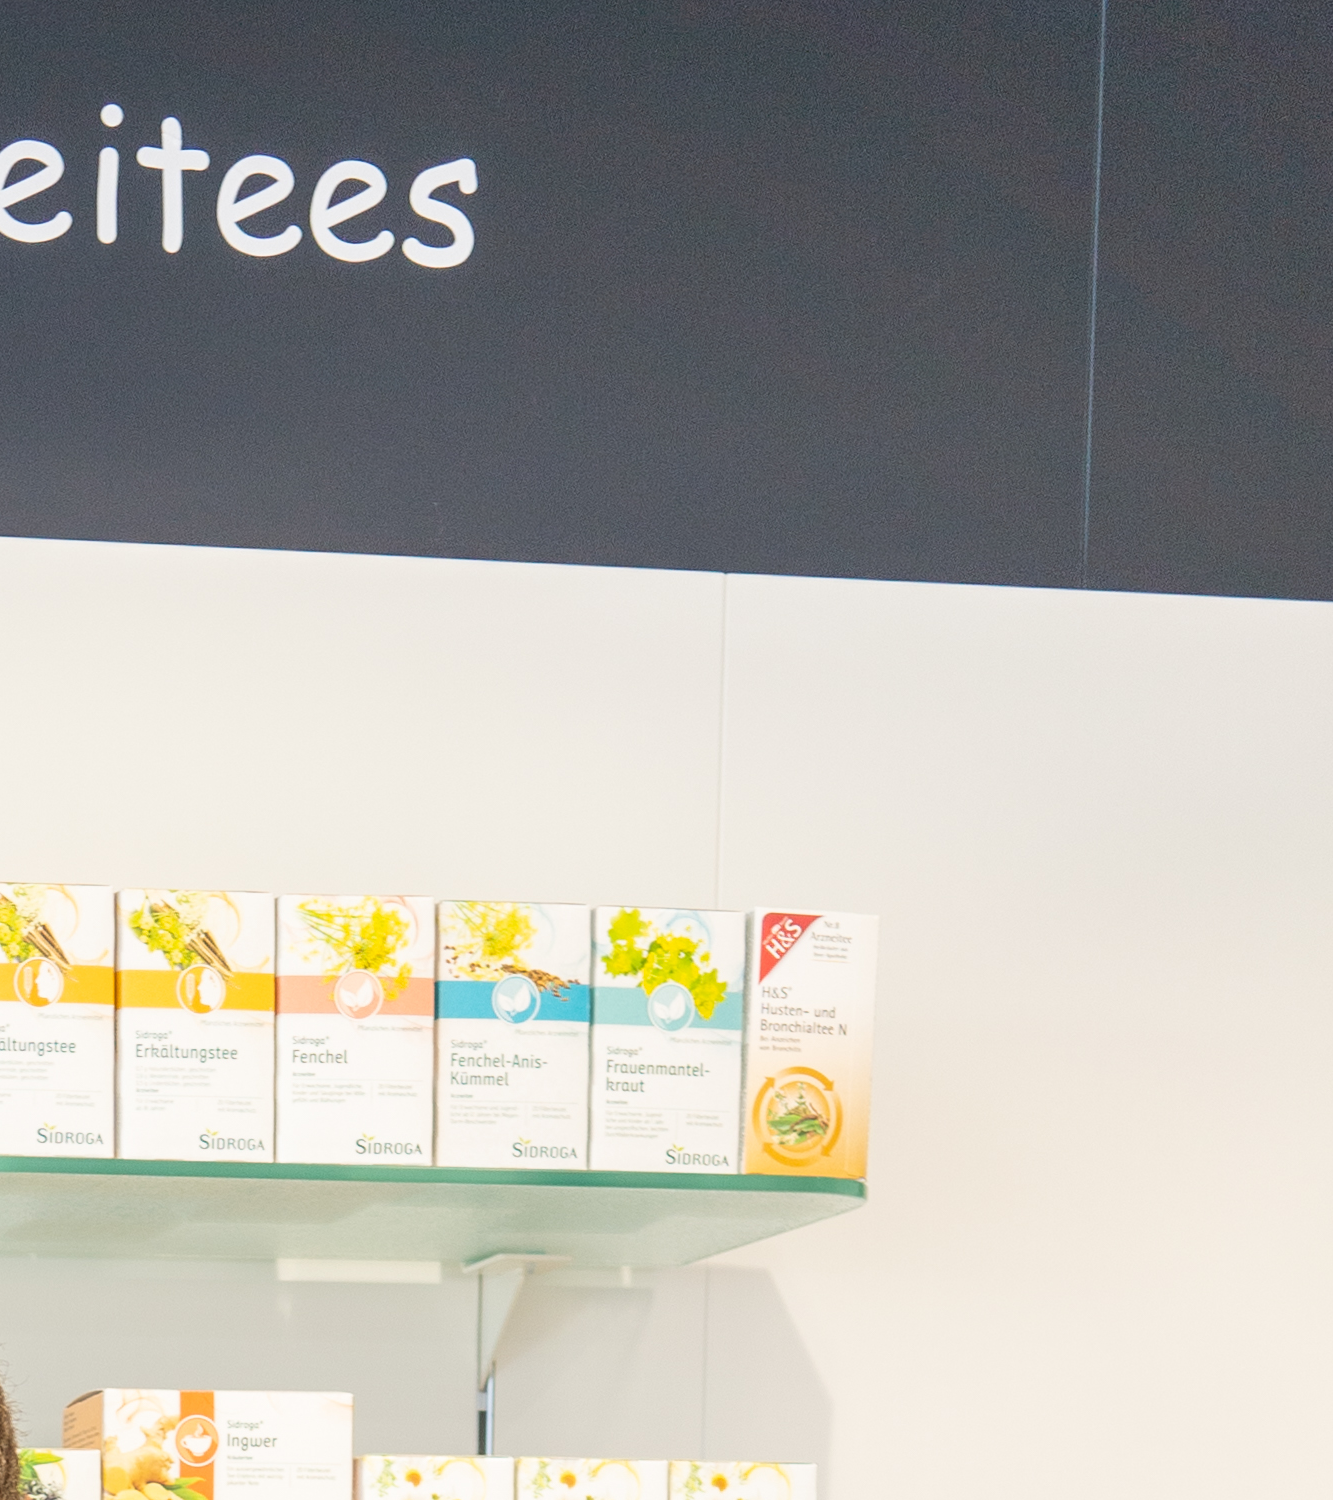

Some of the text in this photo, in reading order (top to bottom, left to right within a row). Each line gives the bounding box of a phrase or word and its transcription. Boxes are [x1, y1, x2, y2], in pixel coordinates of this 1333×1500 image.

[763, 917, 803, 959] H&S
[761, 1003, 836, 1018] Husten- und
[760, 1019, 847, 1036] Bronchialtee N
[292, 1049, 348, 1064] Fenchel
[450, 1054, 547, 1070] Fenchel-Anis-
[606, 1060, 710, 1077] Frauenmantel-
[450, 1072, 509, 1087] Kümmel
[606, 1078, 644, 1092] kraut
[227, 1434, 277, 1449] Ingwer
